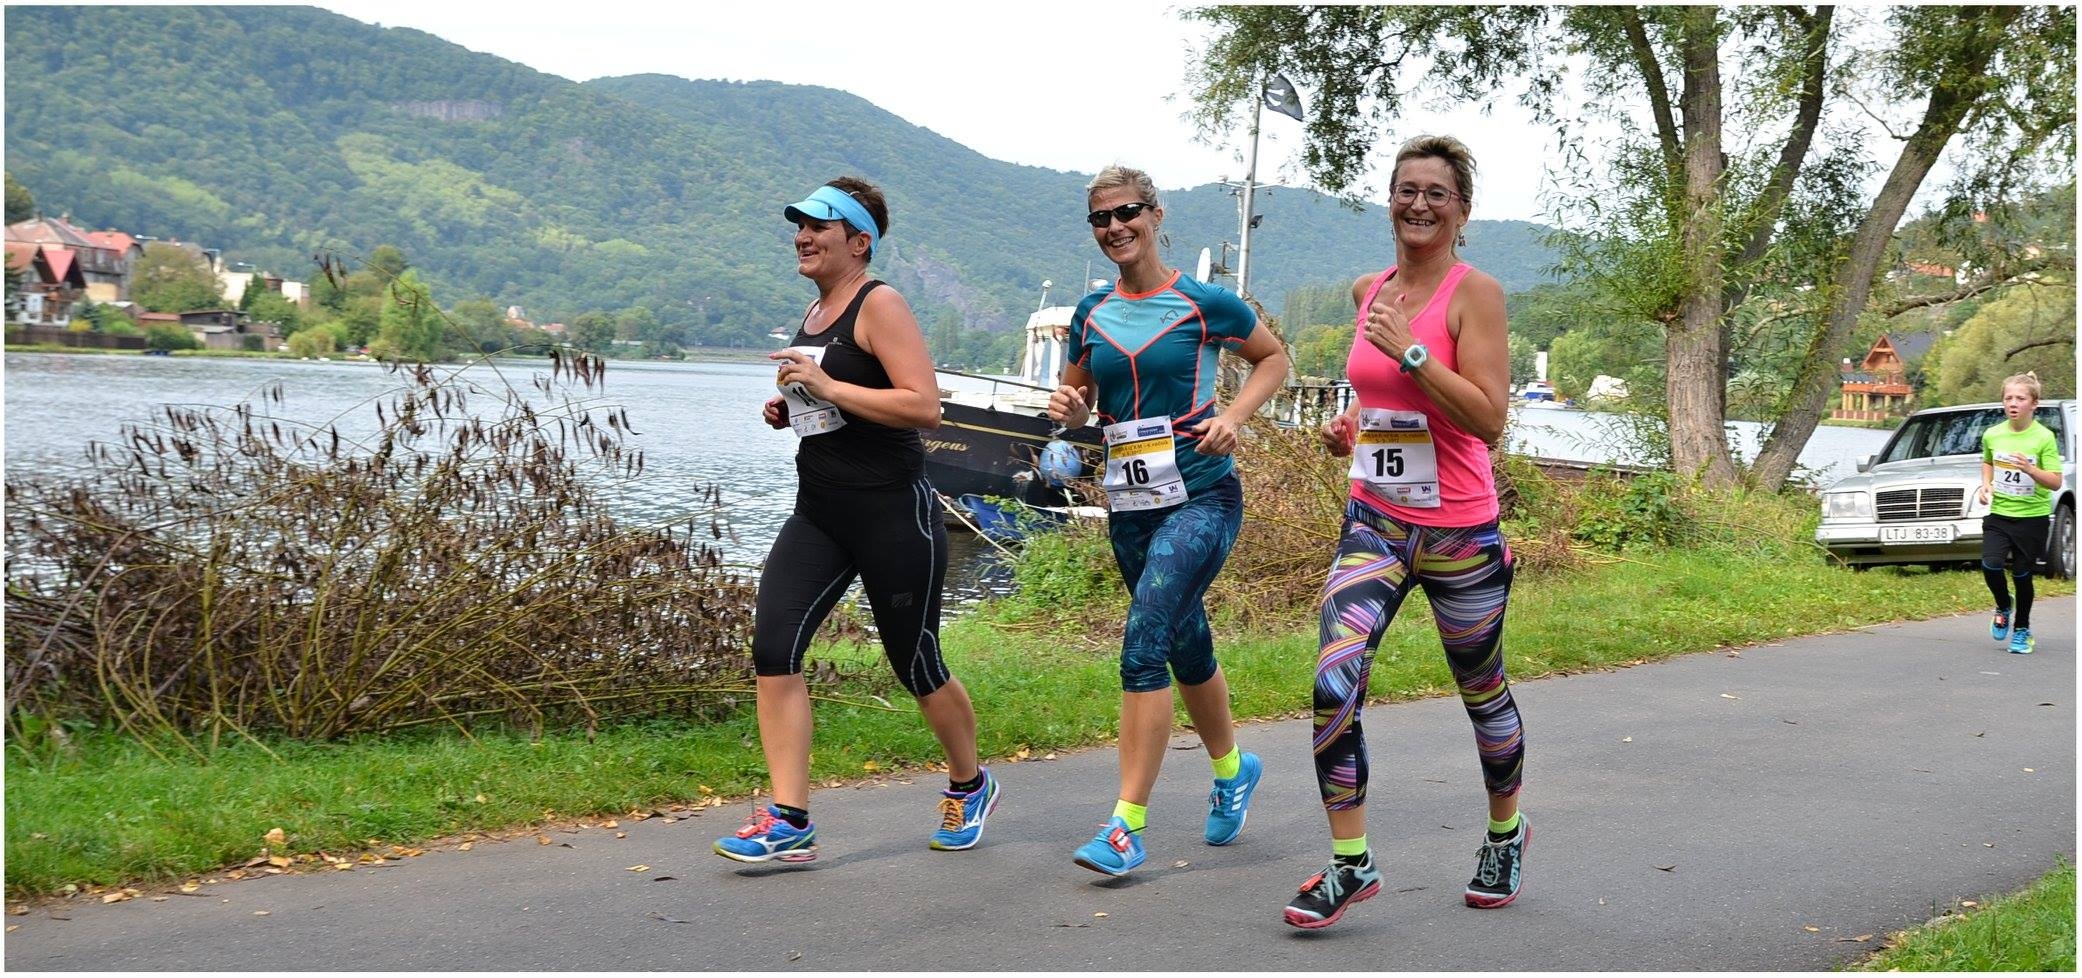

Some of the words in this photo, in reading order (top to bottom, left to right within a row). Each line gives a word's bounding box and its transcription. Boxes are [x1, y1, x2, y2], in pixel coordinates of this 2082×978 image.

[1122, 459, 1150, 486] 16
[1371, 448, 1405, 477] 15
[2004, 470, 2021, 484] 24
[1886, 528, 1907, 540] LTJ
[1915, 527, 1948, 539] 83-38
